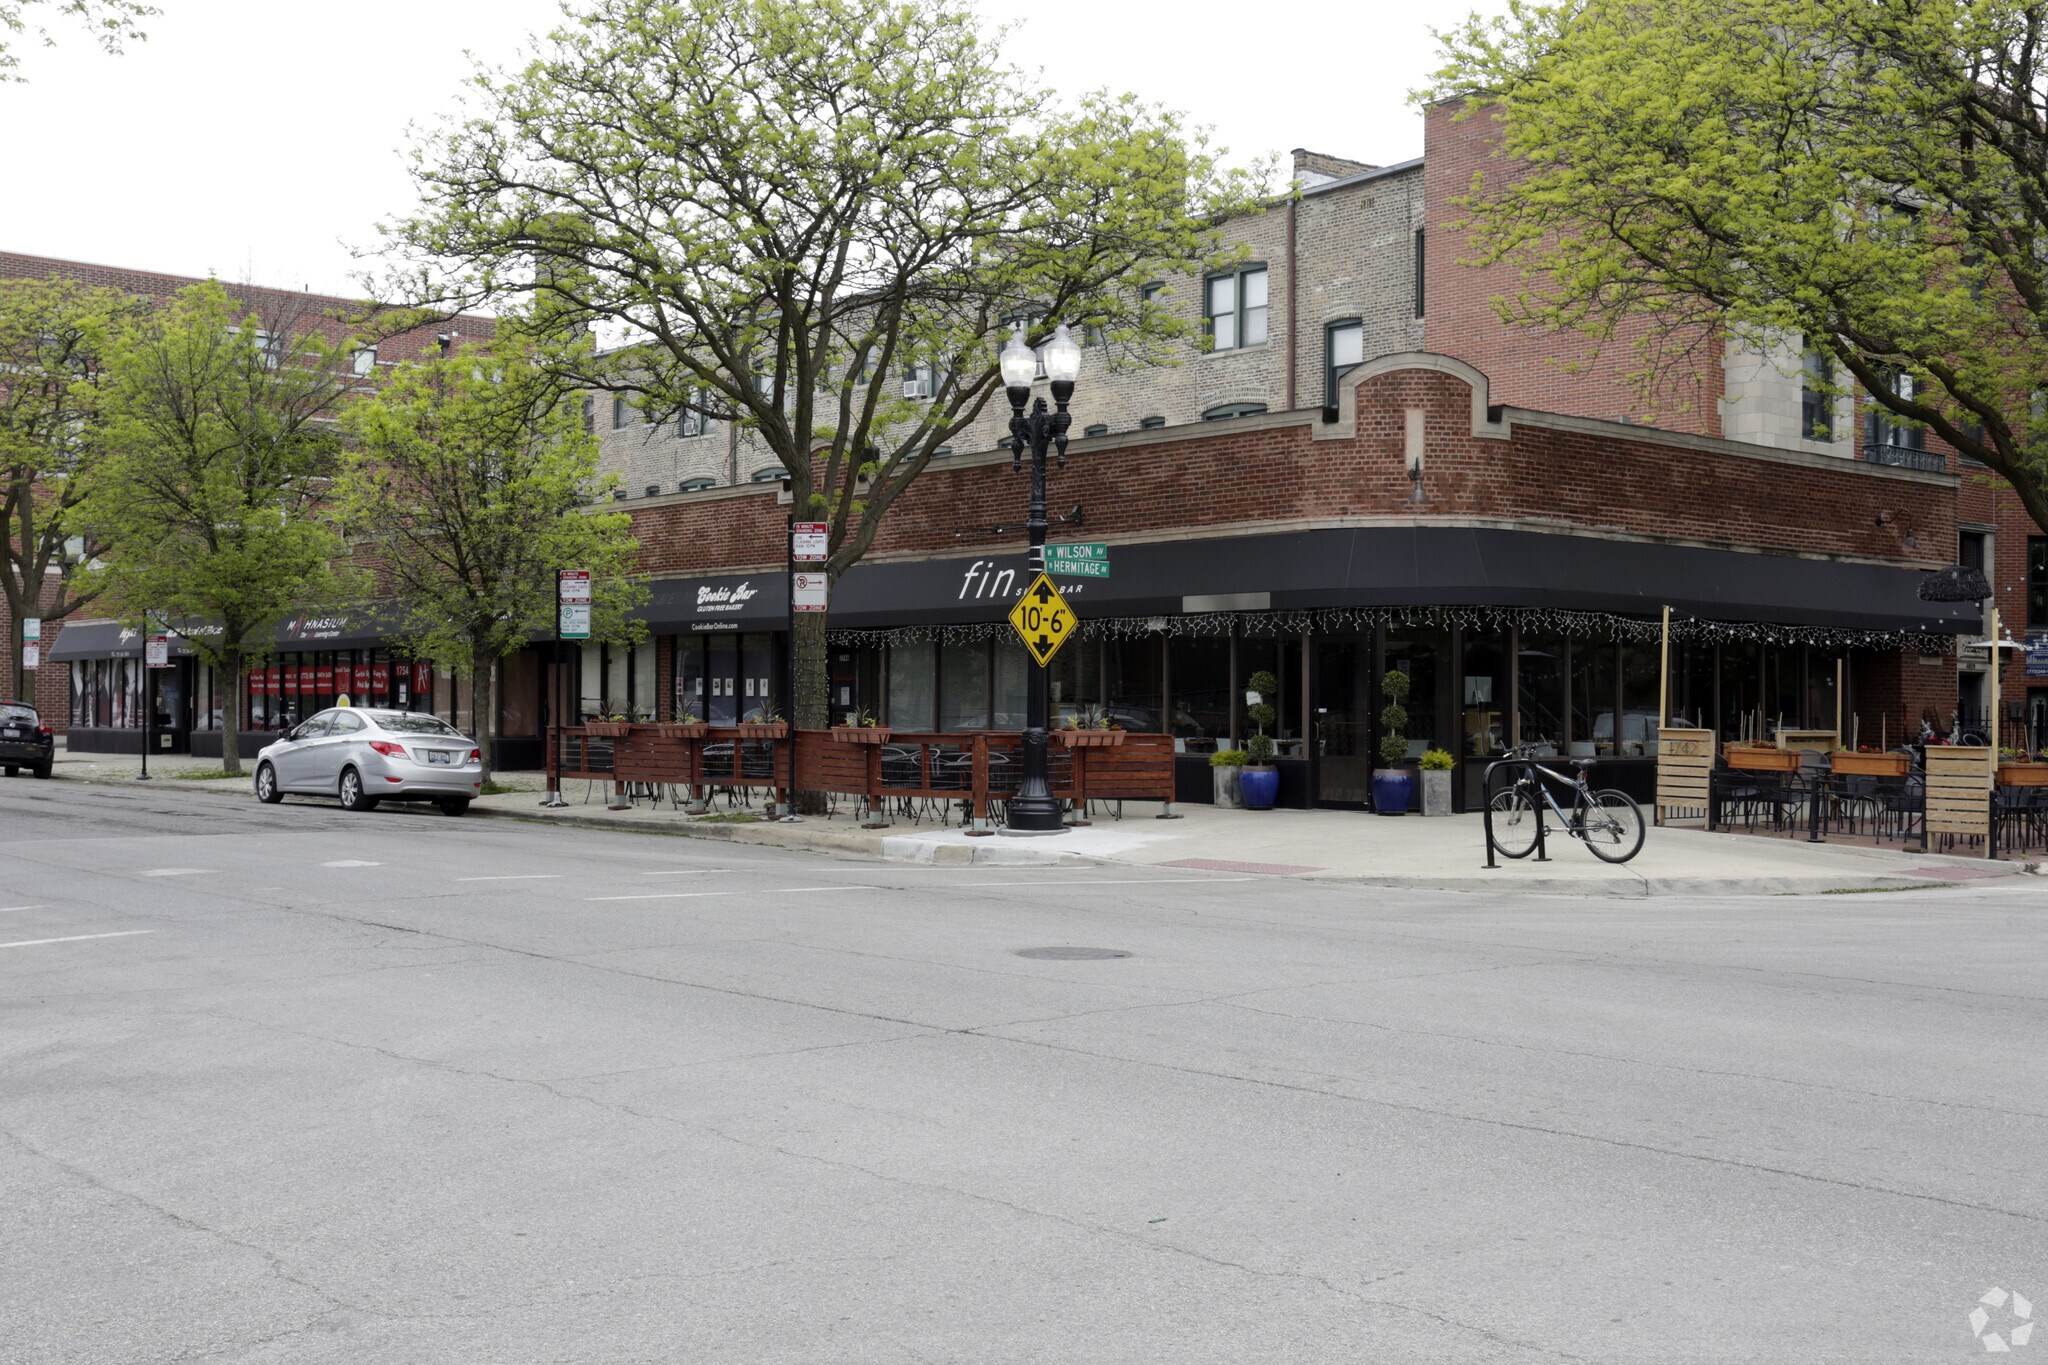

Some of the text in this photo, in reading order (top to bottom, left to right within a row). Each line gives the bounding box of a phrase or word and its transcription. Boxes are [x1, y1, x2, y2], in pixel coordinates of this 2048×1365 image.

[1056, 546, 1092, 558] WILSON
[1054, 561, 1100, 574] HERMITAGE
[958, 560, 1015, 600] fin
[697, 582, 756, 604] Cookie Bar
[1059, 584, 1083, 594] BAR
[692, 622, 738, 631] CookieBarOnline.com
[396, 666, 409, 676] 1754
[417, 664, 428, 692] A+
